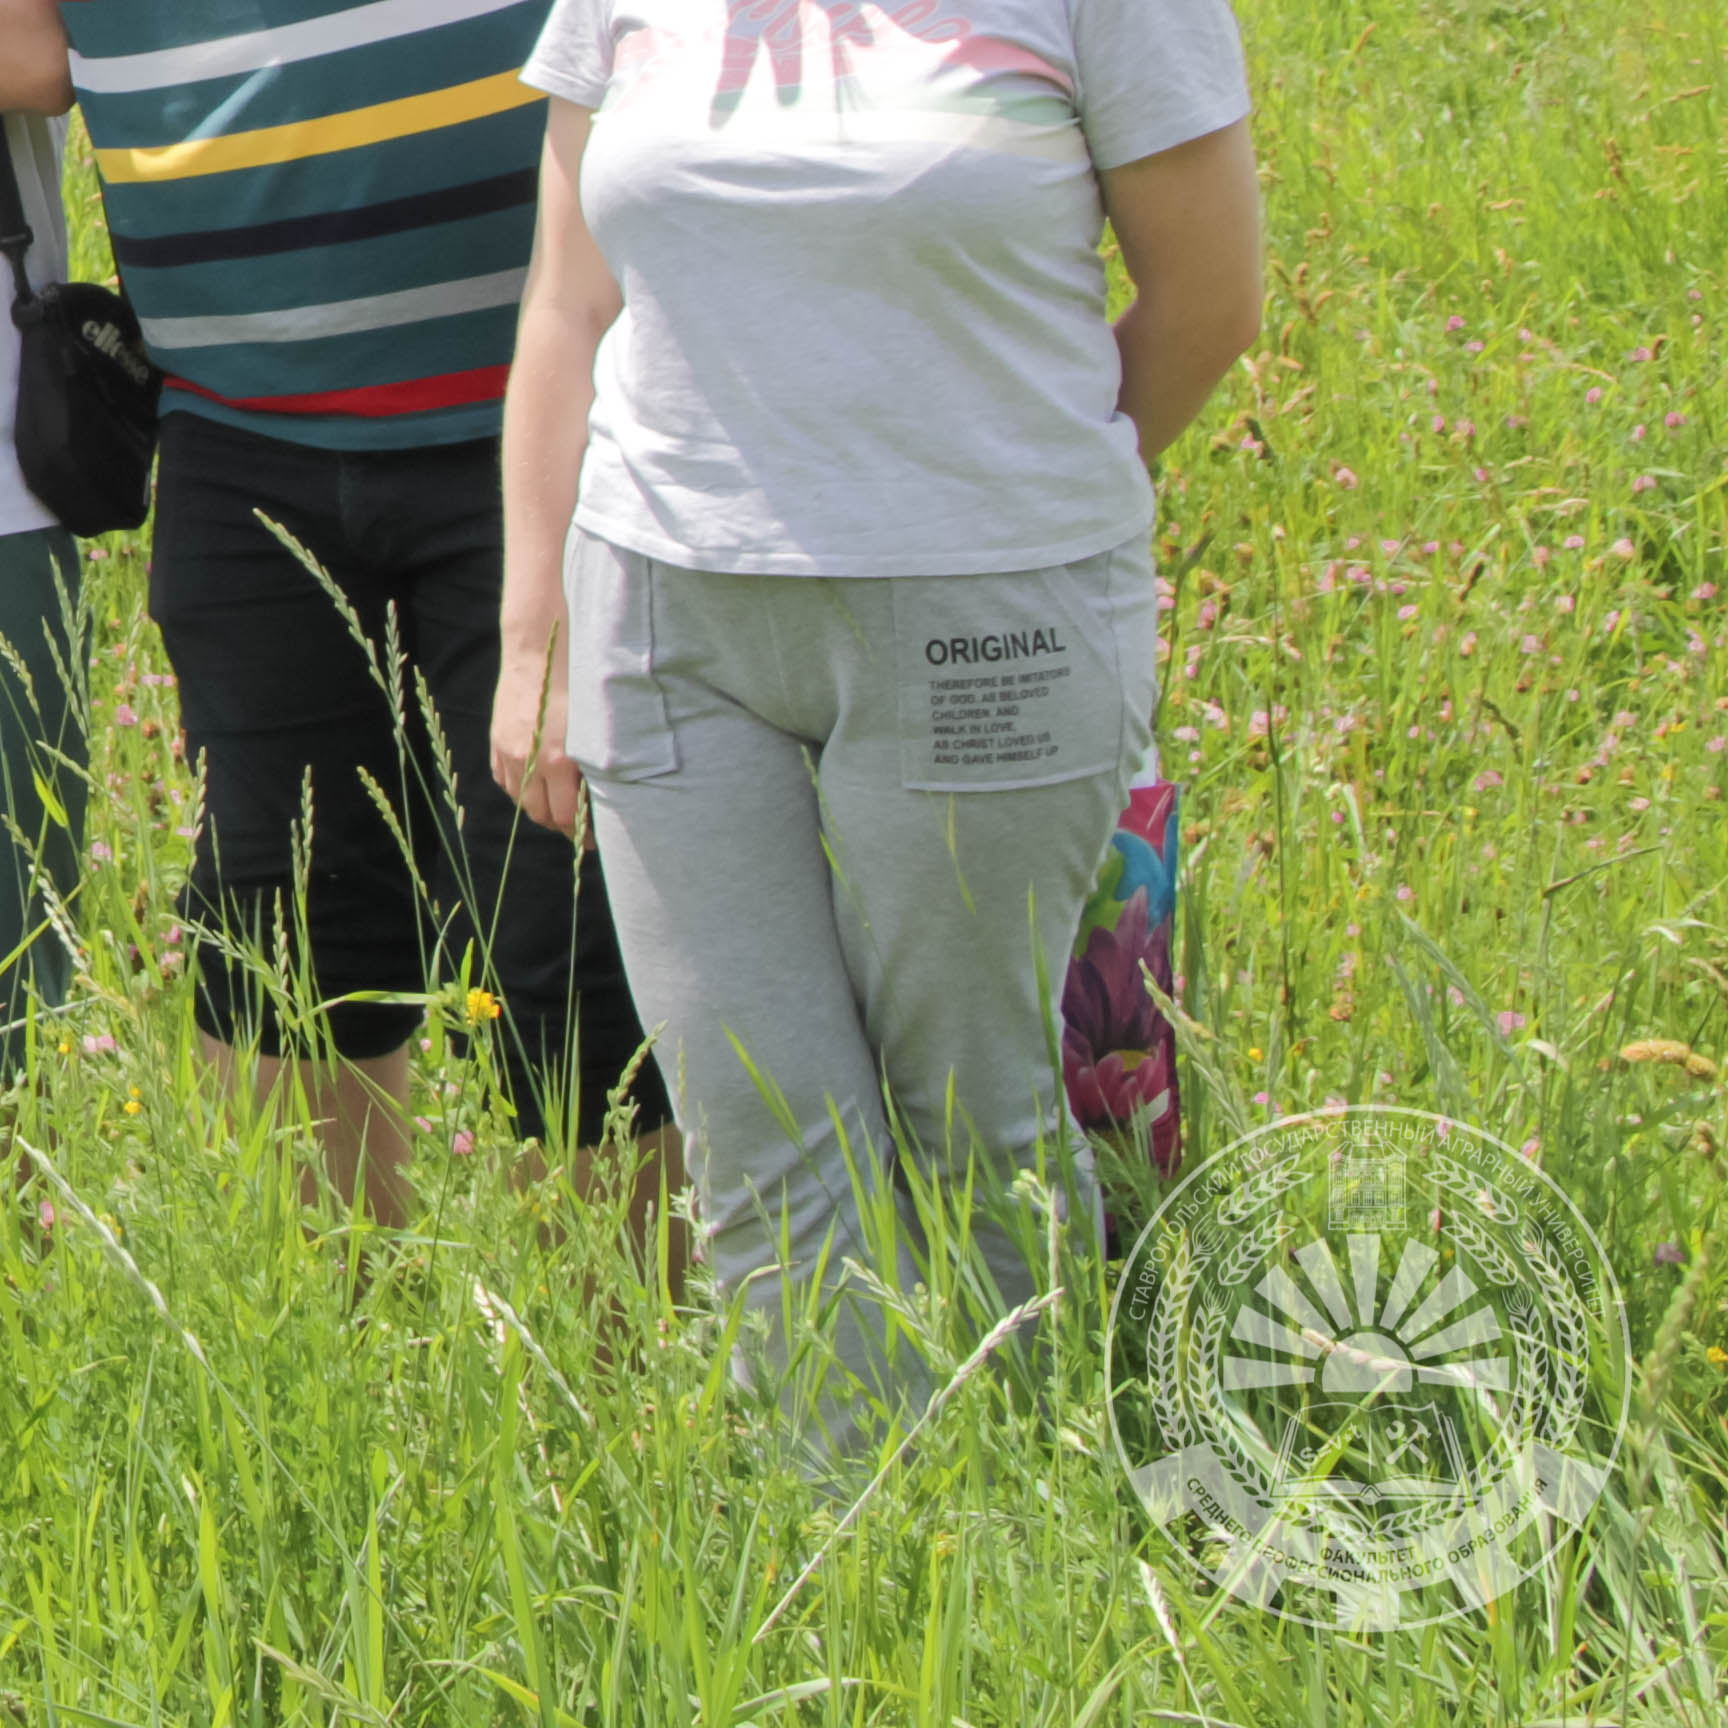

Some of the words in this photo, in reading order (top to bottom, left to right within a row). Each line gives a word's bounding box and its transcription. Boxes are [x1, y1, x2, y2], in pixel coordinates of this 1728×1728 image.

[925, 627, 1066, 666] ORIGINAL
[928, 676, 999, 690] THEREFORE
[1001, 674, 1015, 687] BE
[1018, 666, 1072, 684] IMITATORS
[930, 695, 946, 706] OF
[981, 692, 996, 703] AS
[999, 686, 1050, 702] BELOVED
[995, 705, 1020, 716] AND
[932, 724, 967, 735] WALK
[969, 724, 981, 734] IN
[933, 739, 949, 751] AS
[951, 737, 995, 751] CHRIST
[997, 734, 1036, 749] LOVED
[1037, 730, 1051, 744] US
[933, 753, 960, 765] AND
[961, 751, 994, 765] GAVE
[996, 748, 1043, 762] HIMSELF
[1045, 745, 1060, 757] UP
